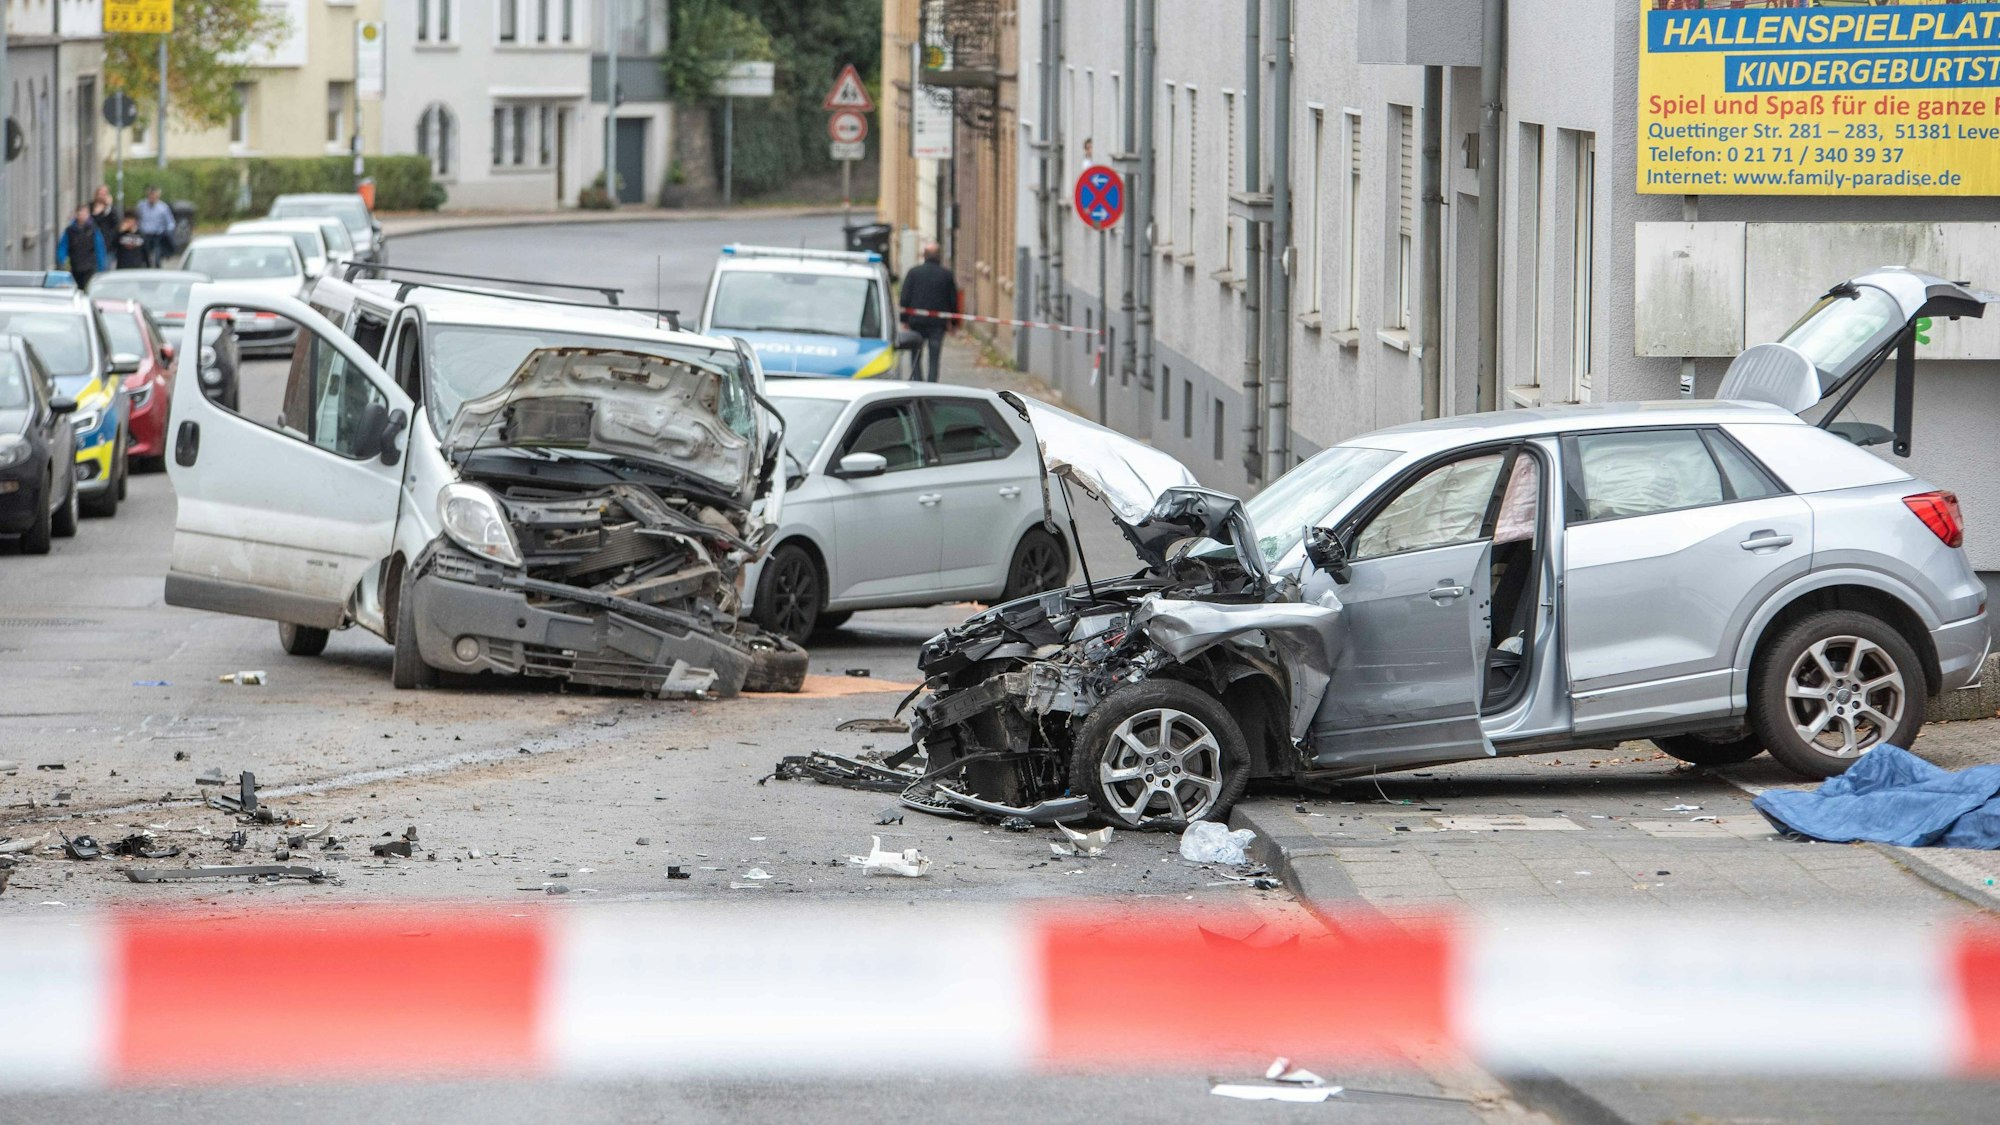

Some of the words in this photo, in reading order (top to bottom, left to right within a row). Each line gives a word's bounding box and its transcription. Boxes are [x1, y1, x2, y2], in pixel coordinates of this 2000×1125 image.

[1662, 11, 2000, 46] HALLENSPIELPLAT
[1736, 56, 2000, 86] KINDERGEBURTST
[1649, 95, 1706, 119] Spiel
[1714, 95, 1758, 115] und
[1766, 94, 1825, 120] Spaß
[1832, 95, 1867, 116] für
[1874, 95, 1910, 116] die
[1917, 100, 1986, 121] ganze
[1648, 122, 1748, 142] Quettinger
[1753, 123, 1783, 139] Str.
[1789, 123, 1821, 139] 281
[1844, 124, 1884, 142] 283,
[1895, 123, 1951, 140] 51381
[1649, 146, 1722, 162] Telefon:
[1727, 147, 1738, 162] 0
[1744, 147, 1765, 162] 21
[1772, 147, 1793, 162] 71
[1814, 147, 1848, 163] 340
[1854, 148, 1876, 163] 39
[1882, 148, 1904, 163] 37
[1647, 169, 1727, 185] Internet:
[1733, 169, 1961, 189] www.family-paradise.de
